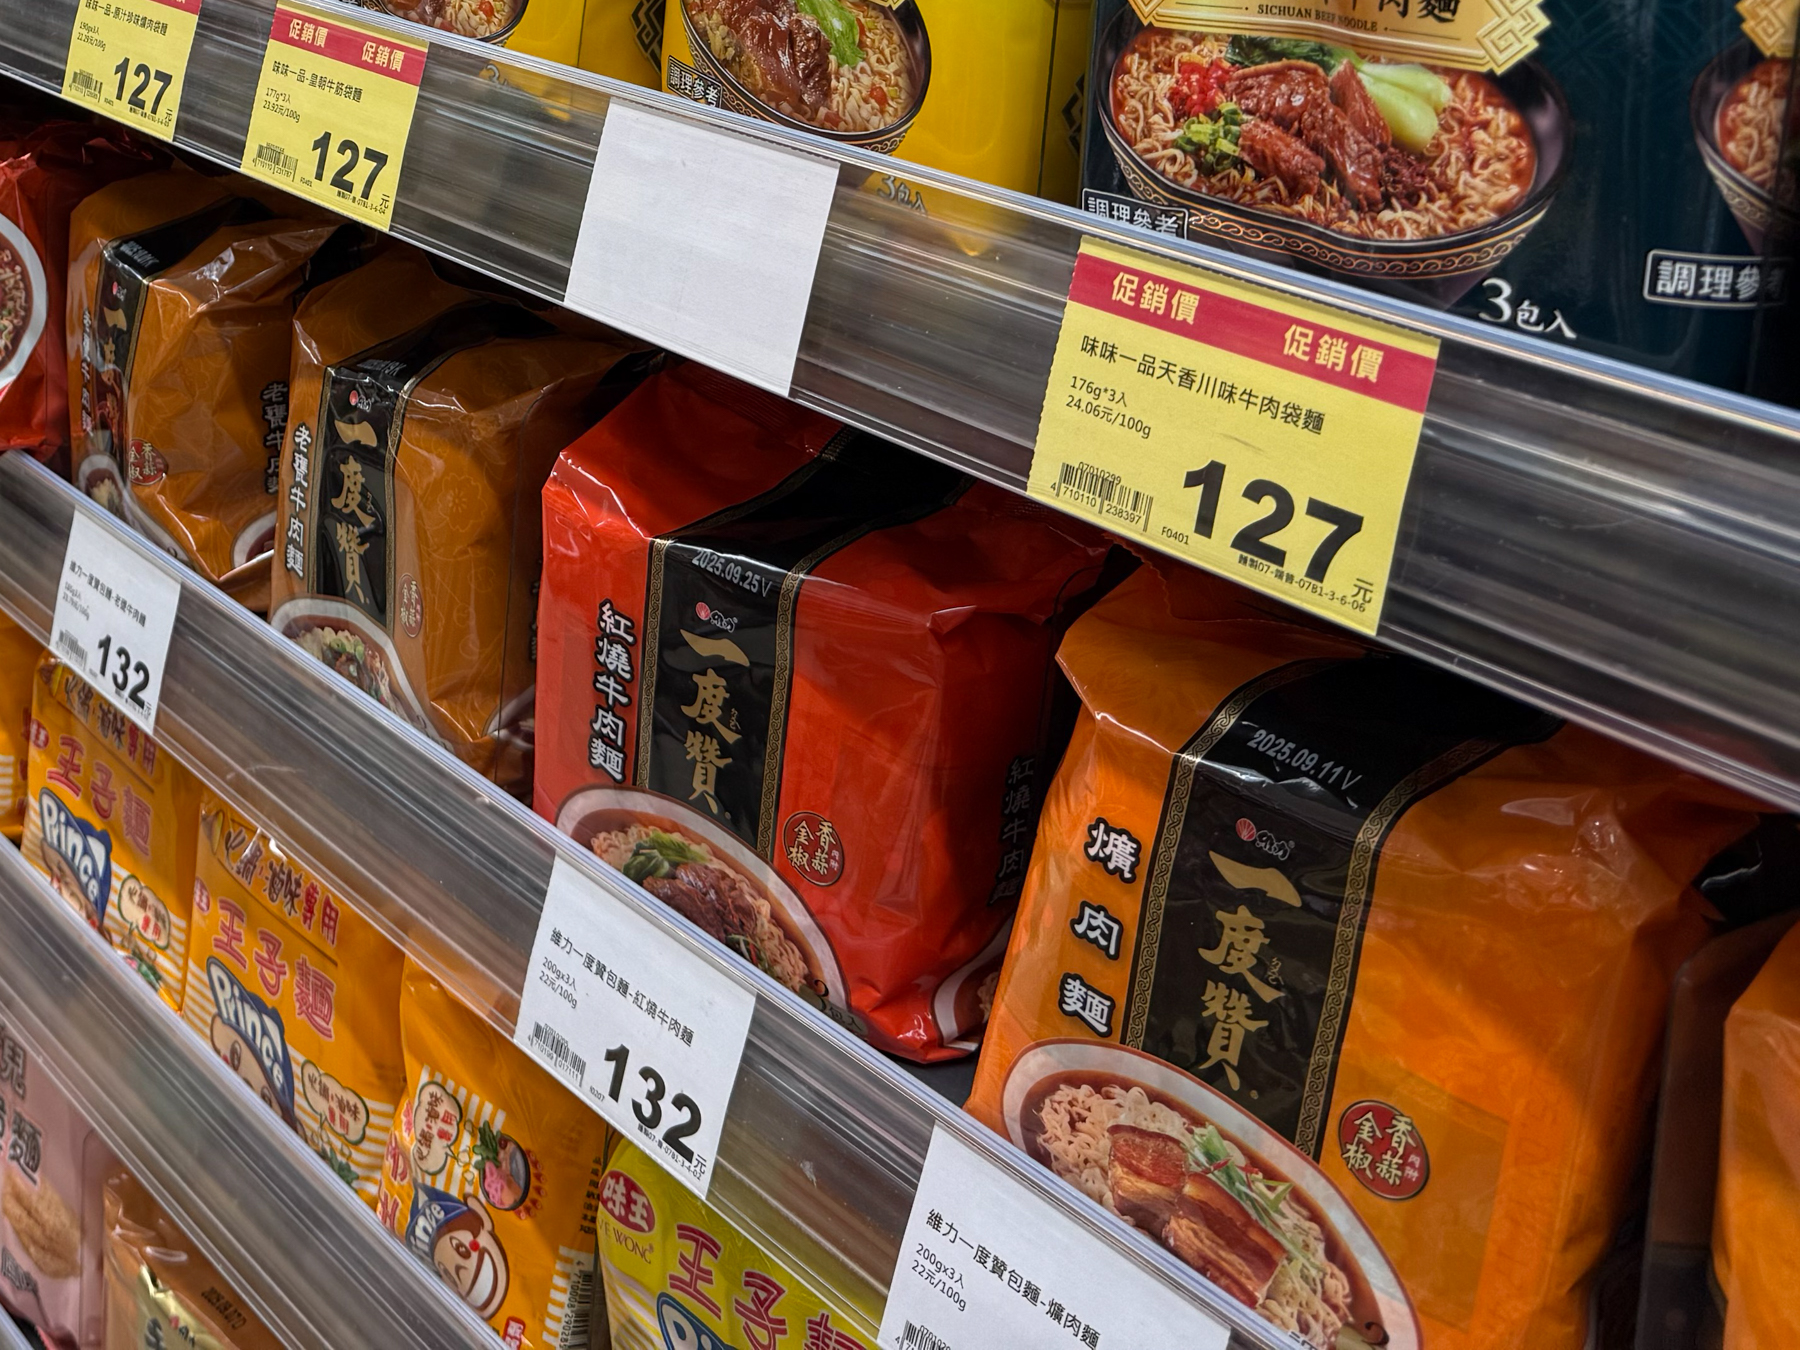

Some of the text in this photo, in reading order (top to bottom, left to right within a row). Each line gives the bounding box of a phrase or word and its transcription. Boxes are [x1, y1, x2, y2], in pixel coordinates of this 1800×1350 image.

[287, 18, 406, 74] 促銷價 促銷價
[1256, 3, 1378, 33] SICHUAN BEEF NOODLE
[113, 56, 174, 117] 127
[271, 59, 364, 105] 味味一品-皇朝牛筋袋麵
[262, 99, 301, 125] 23.92元/100g
[311, 130, 390, 210] 127 元
[1111, 271, 1385, 384] 促銷價 促銷價
[1479, 276, 1577, 341] 3包入
[1080, 334, 1326, 436] 味味一品天香川味牛肉袋麵
[1065, 394, 1152, 440] 24.06元/100g
[1062, 488, 1098, 508] 710110
[1105, 505, 1142, 525] 238397
[1160, 526, 1190, 546] F0401
[1182, 458, 1375, 605] 127 元
[97, 633, 150, 711] 132
[588, 597, 637, 783] 紅燒牛肉麵
[46, 734, 152, 857] 王子麵
[811, 819, 837, 876] 香蒜
[212, 897, 336, 1041] 王子麵
[539, 970, 578, 1010] 22元/100g
[543, 956, 578, 992] 200gx3入
[209, 965, 284, 1090] Prince
[604, 1043, 707, 1176] 132 元
[1341, 1111, 1383, 1180] 金椒
[1375, 1114, 1417, 1186] 香蒜
[602, 1175, 650, 1232] 味王
[910, 1259, 968, 1313] 22元/100g
[915, 1242, 965, 1291] 200gx3入
